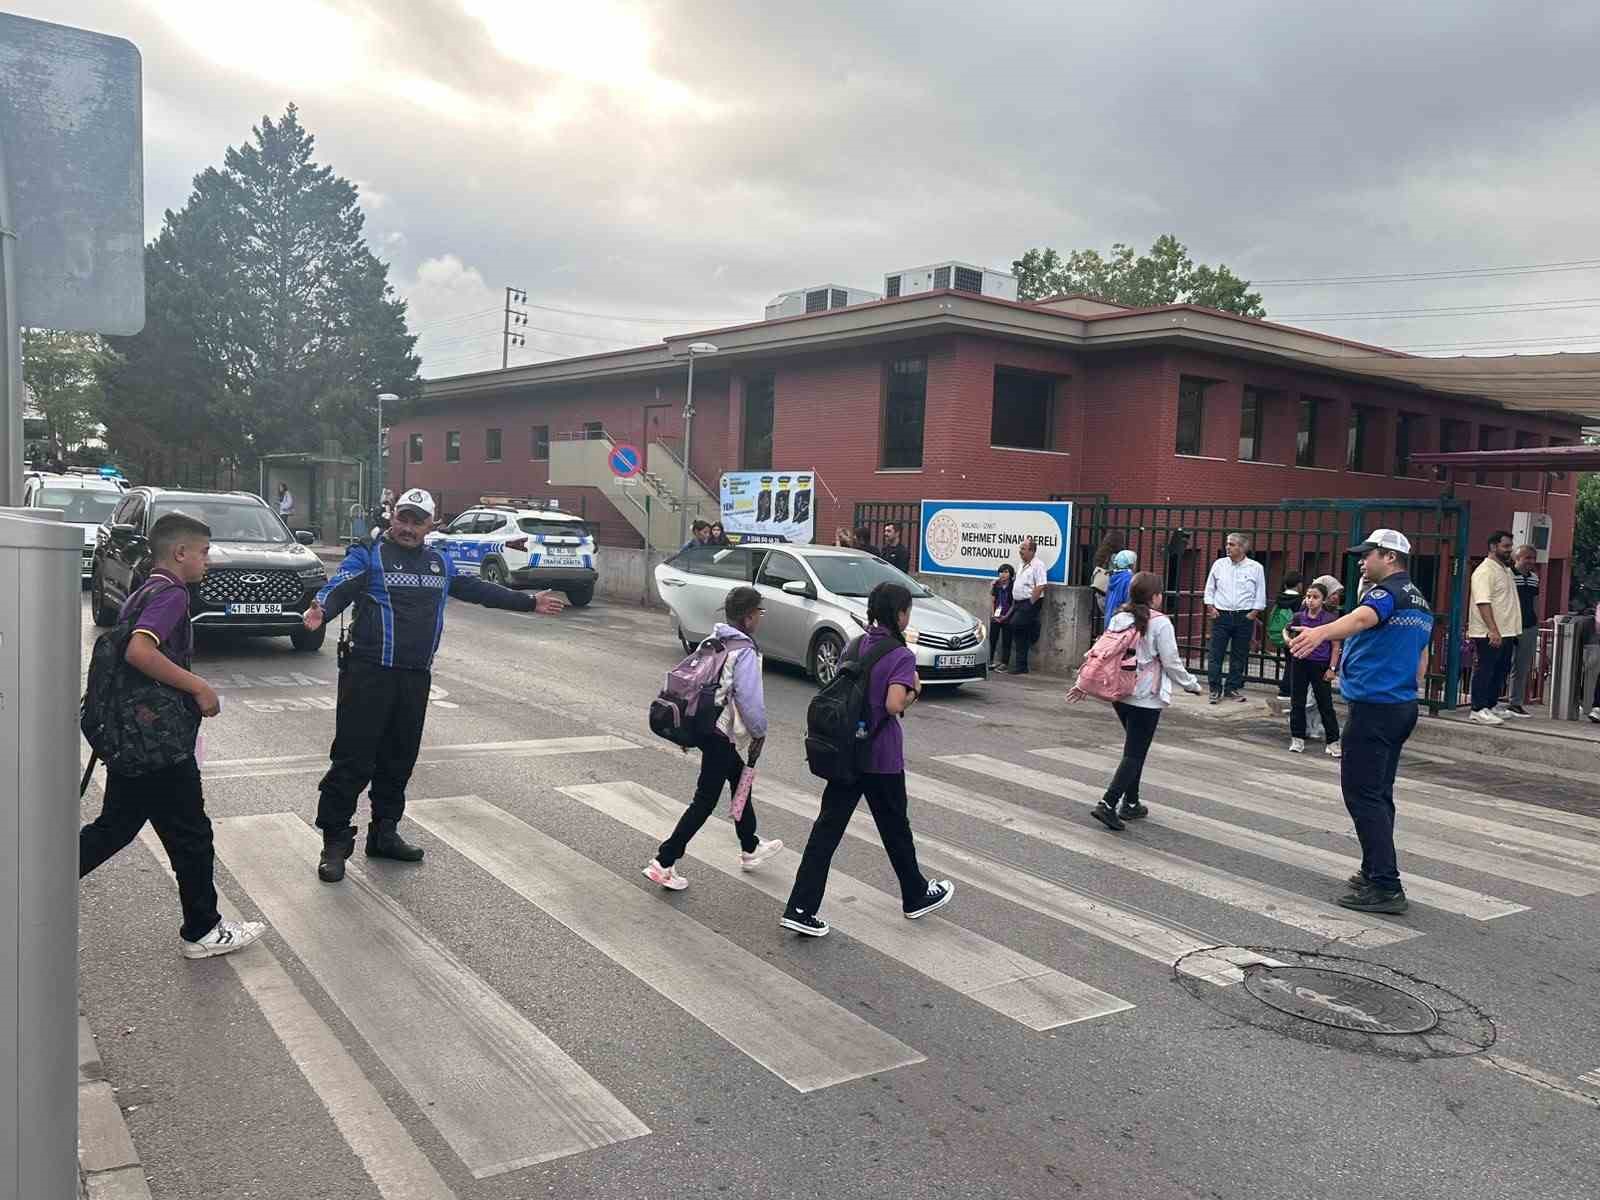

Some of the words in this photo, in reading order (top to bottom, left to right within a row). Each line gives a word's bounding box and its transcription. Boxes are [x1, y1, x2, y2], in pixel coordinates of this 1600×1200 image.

[961, 532, 997, 543] MEHMET
[998, 531, 1025, 545] SİNAN
[960, 546, 1010, 559] ORTAOKULU
[231, 604, 241, 613] 41
[245, 604, 261, 613] BEV
[264, 604, 281, 613] 584
